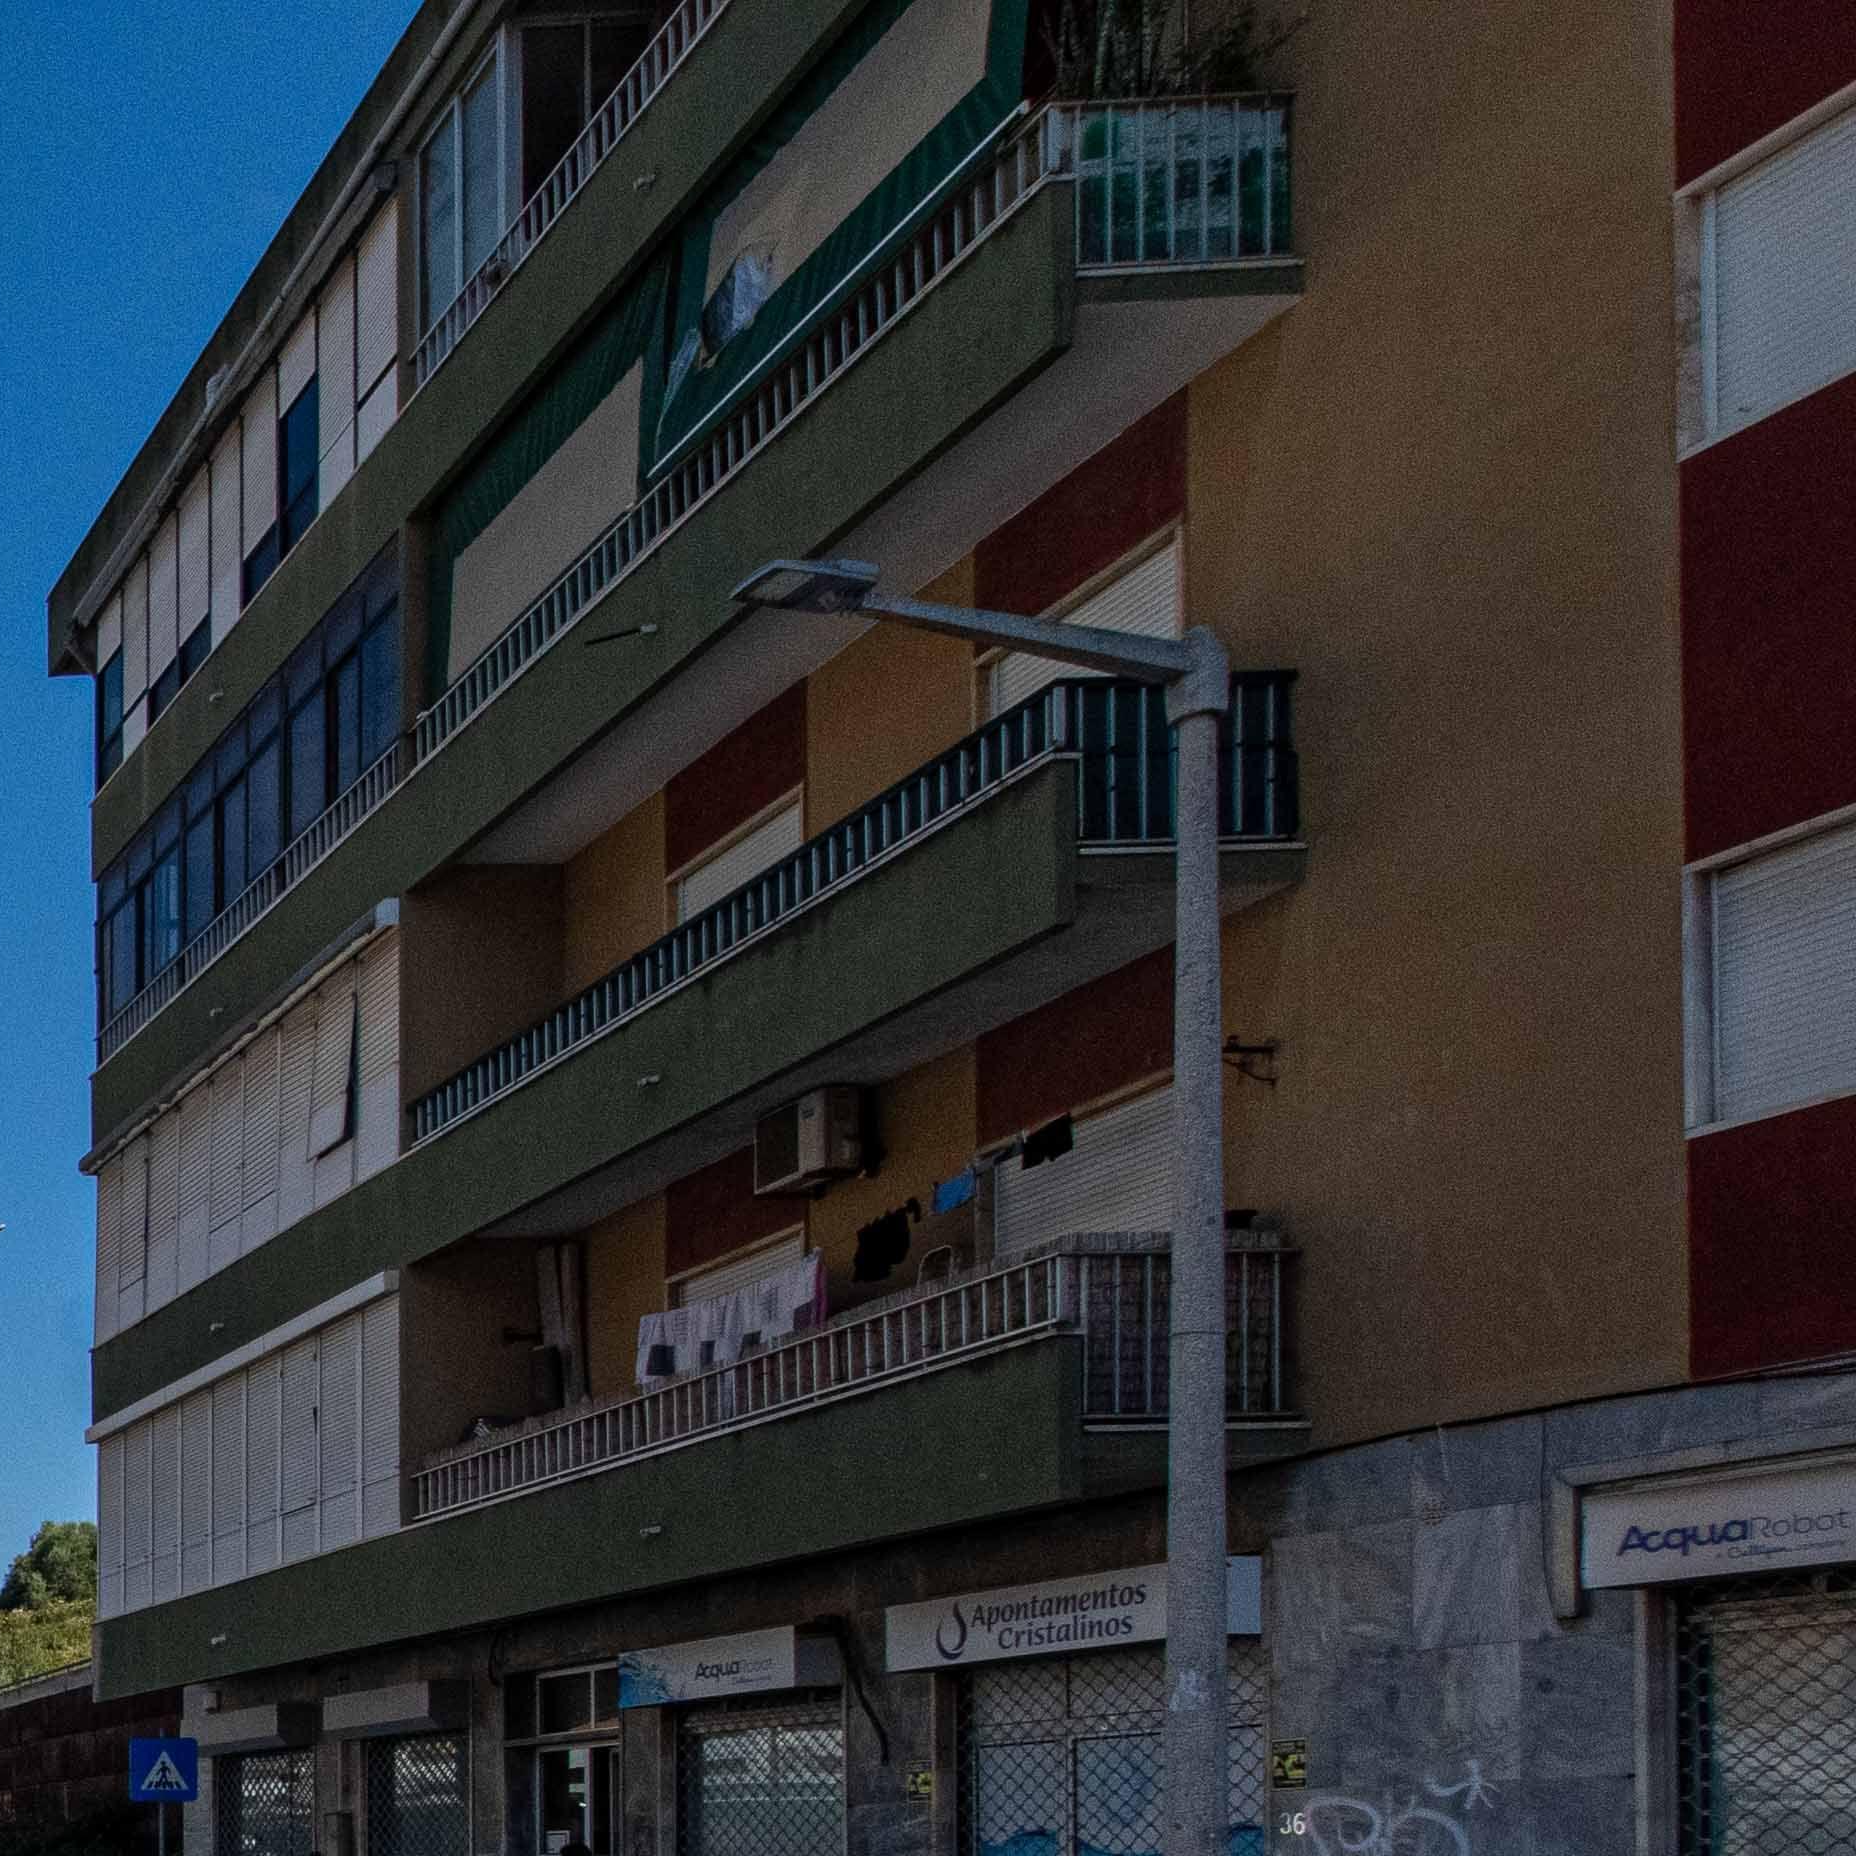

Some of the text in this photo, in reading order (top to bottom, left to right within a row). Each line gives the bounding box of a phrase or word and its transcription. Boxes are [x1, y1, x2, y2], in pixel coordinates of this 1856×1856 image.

[1616, 1508, 1851, 1556] AcquaRobot
[971, 1584, 1147, 1632] Apontamentos
[998, 1615, 1133, 1649] Cristalinos
[1279, 1812, 1306, 1836] 36
